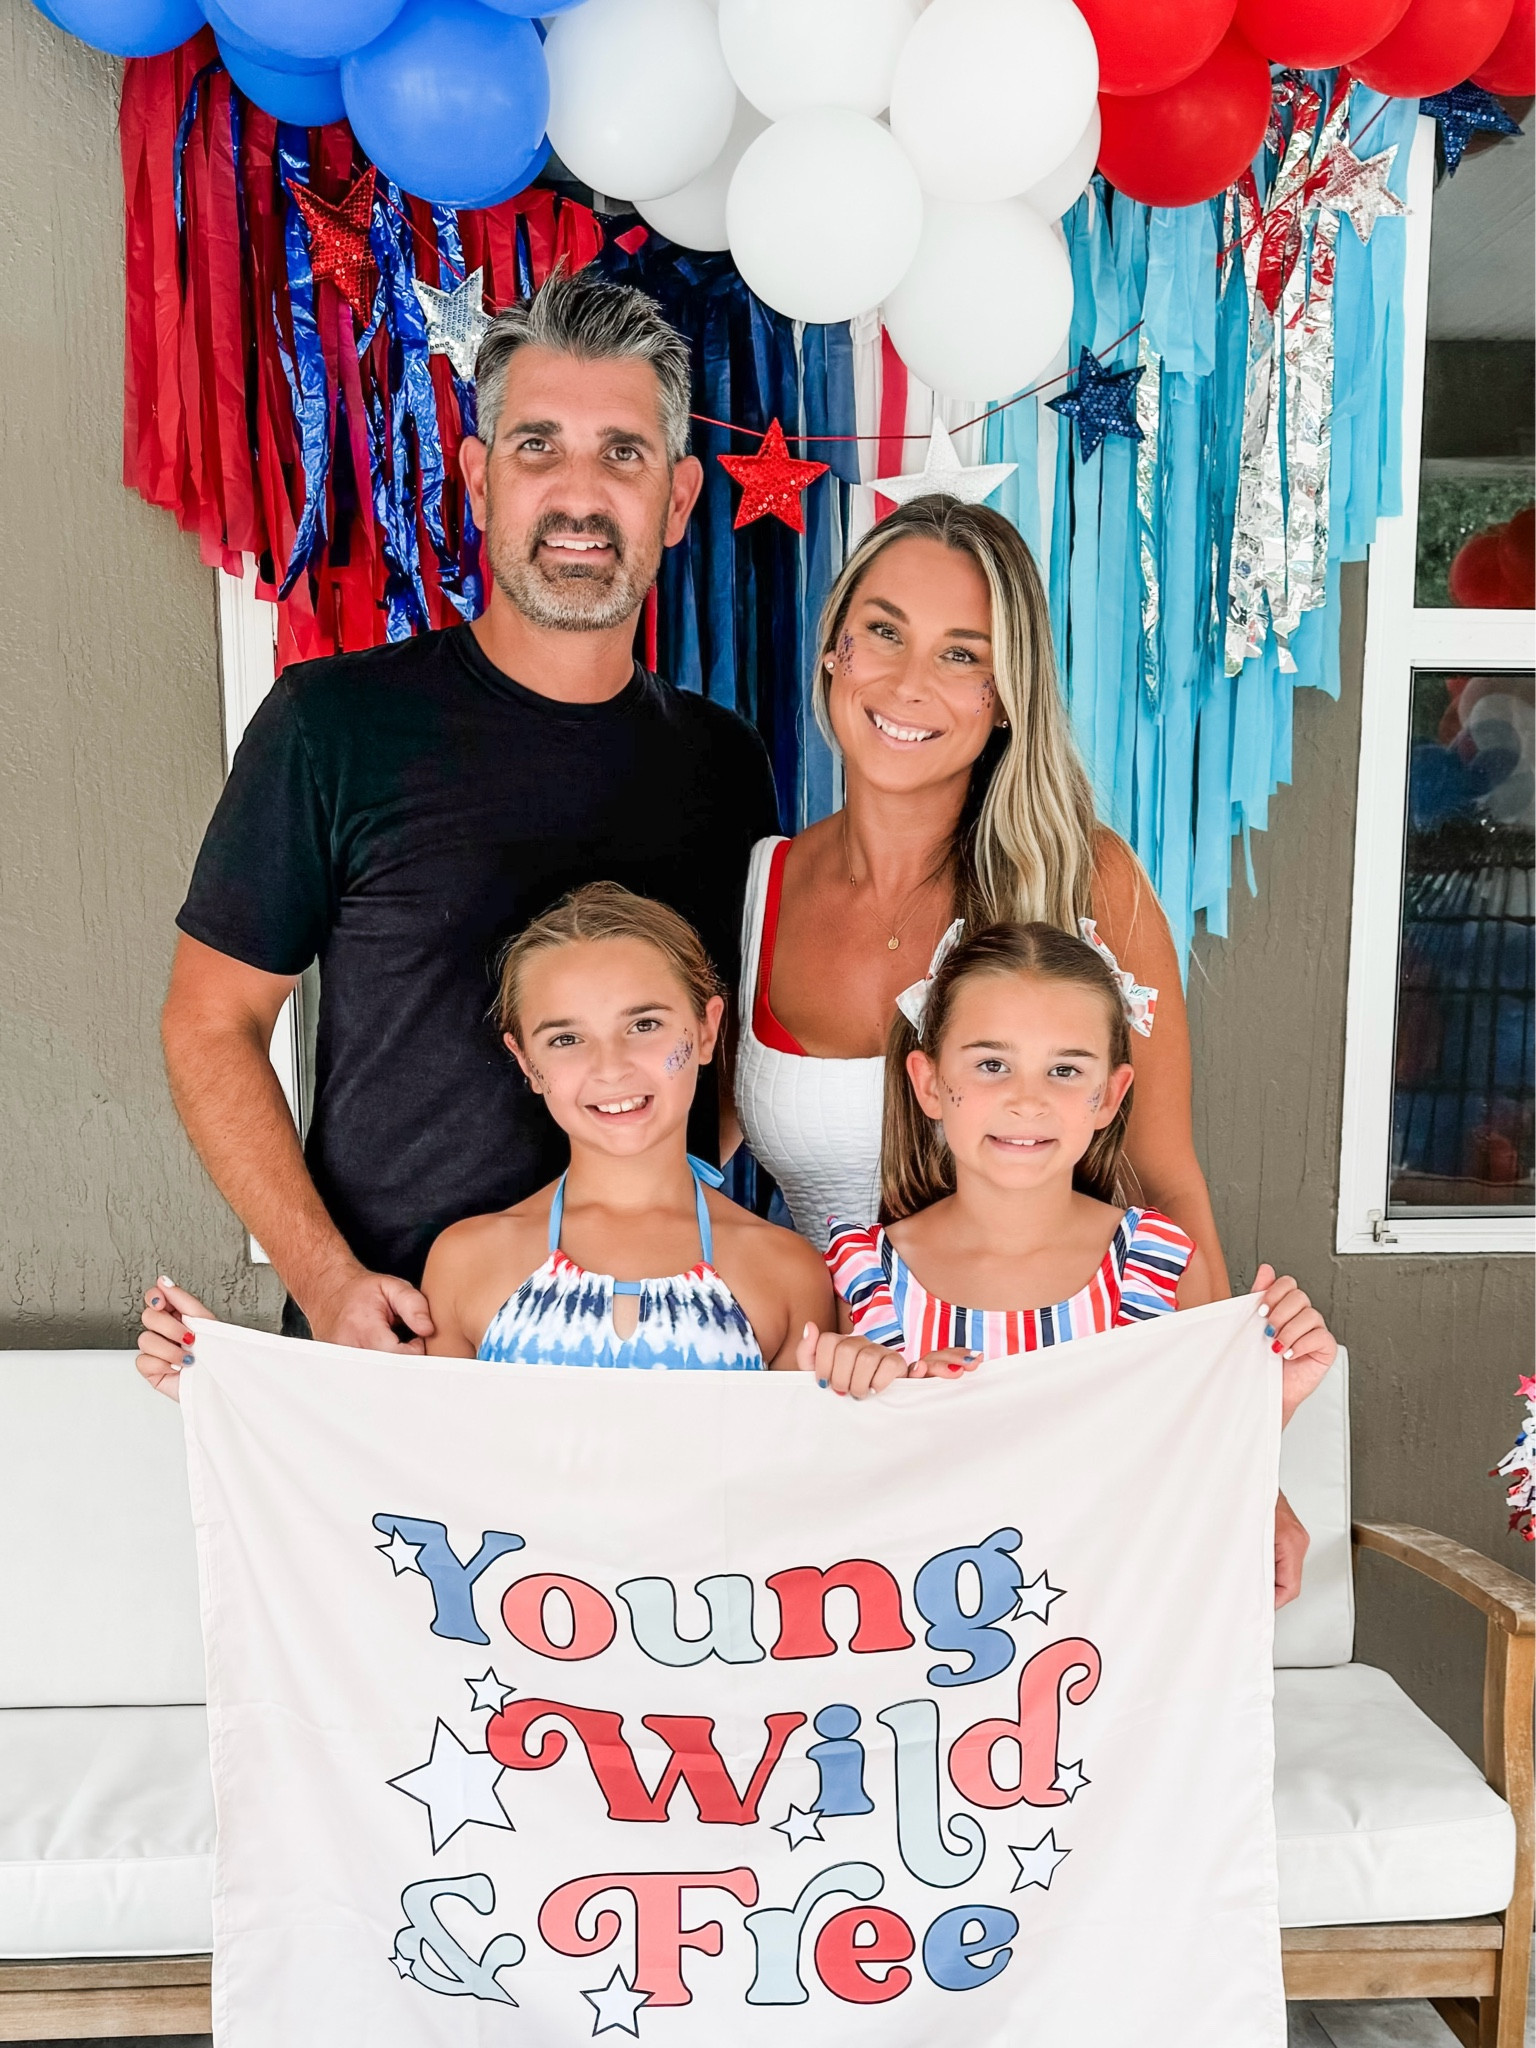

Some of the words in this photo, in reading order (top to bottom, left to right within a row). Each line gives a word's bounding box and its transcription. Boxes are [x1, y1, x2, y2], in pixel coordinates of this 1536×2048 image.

[372, 1513, 1025, 1687] Young
[485, 1637, 1103, 1888] Wild
[395, 1873, 526, 2007] &
[537, 1861, 1020, 2006] Free
